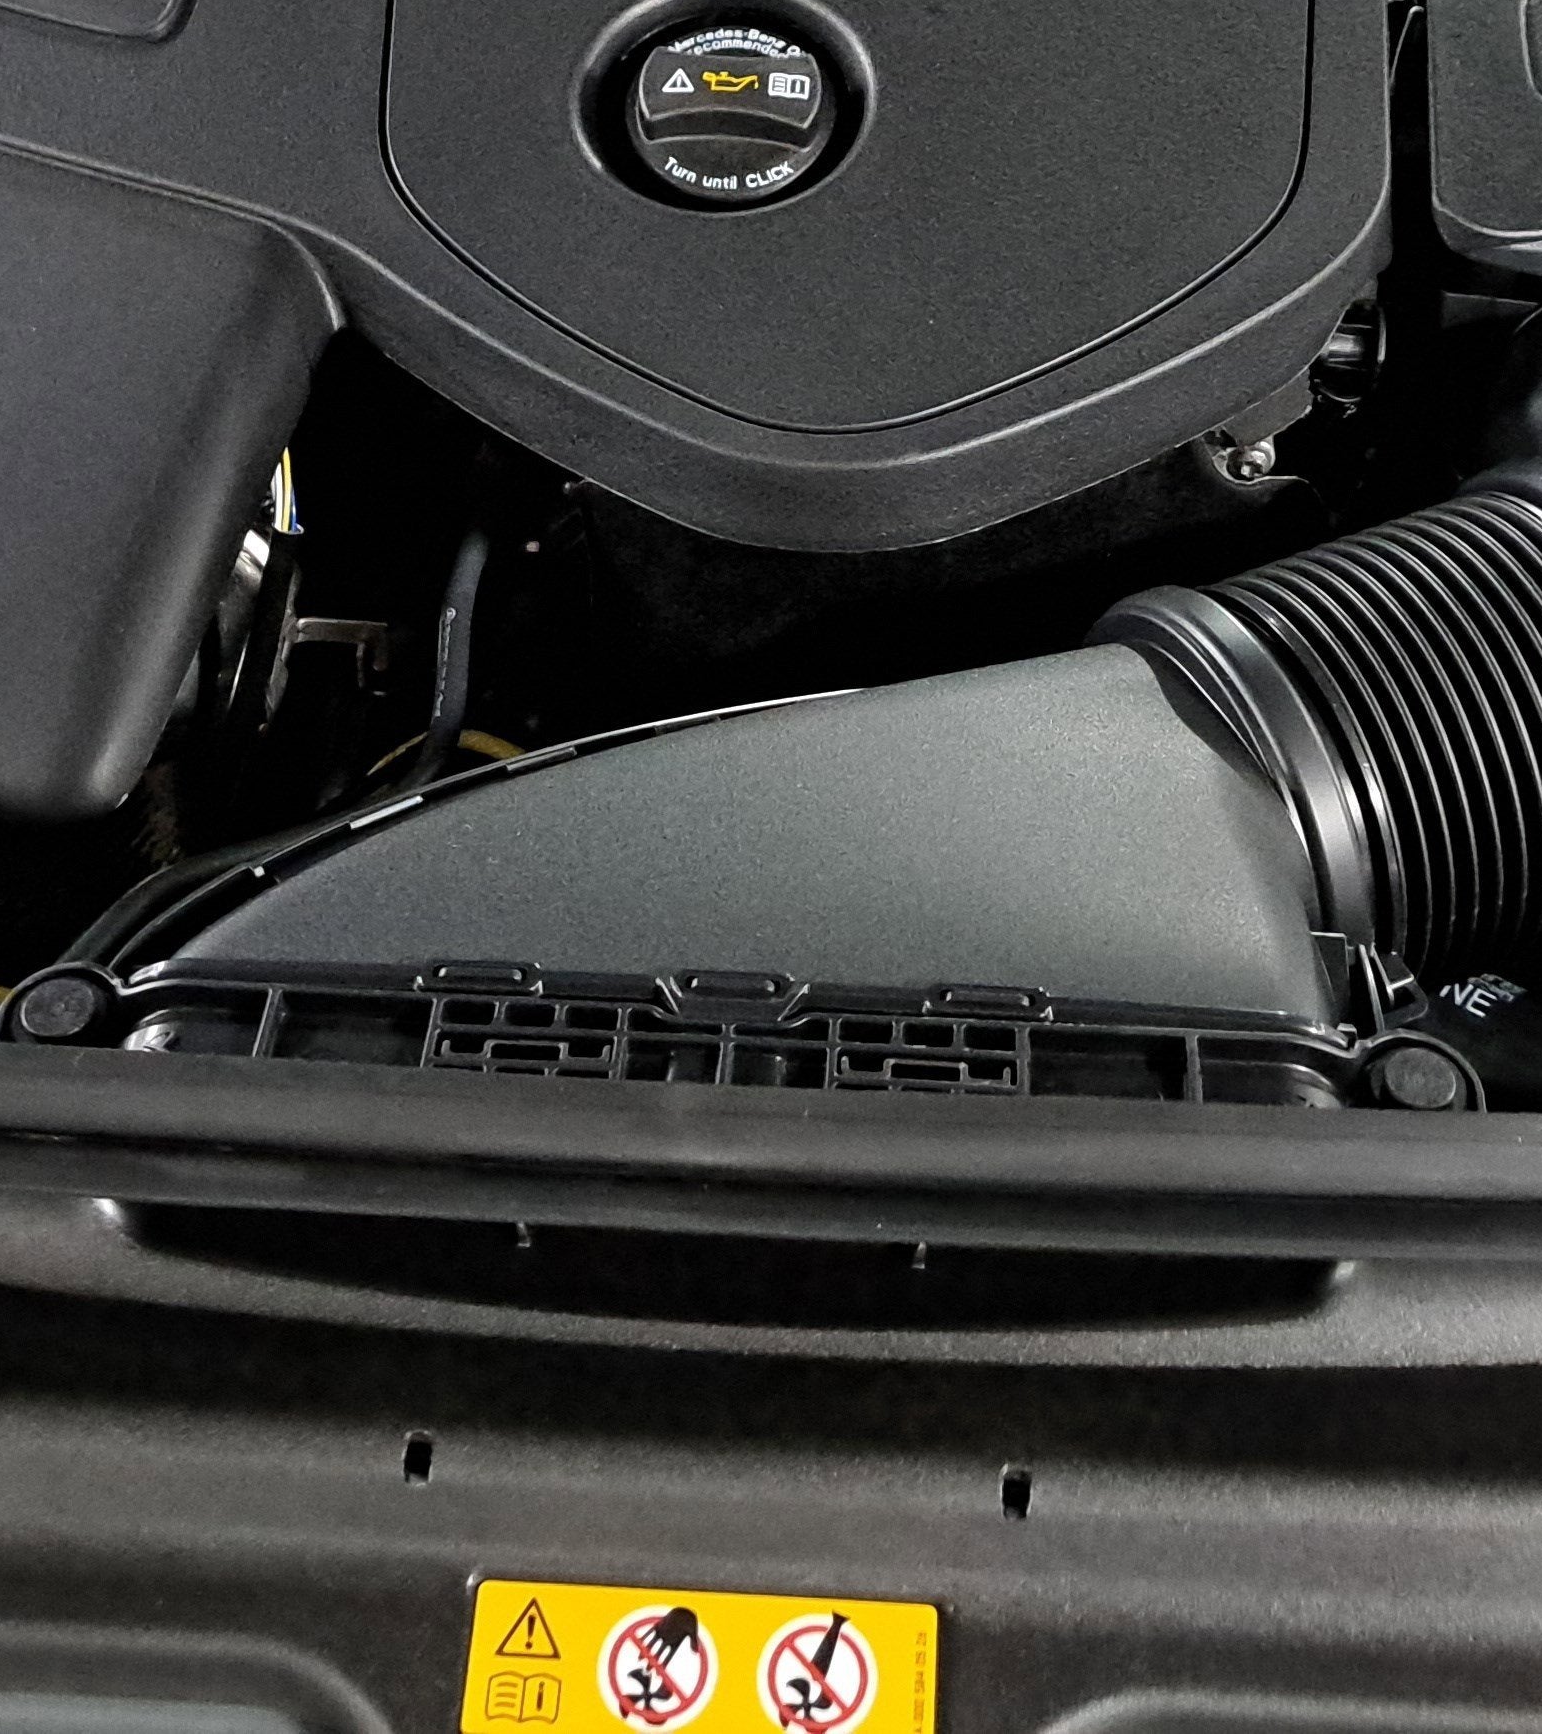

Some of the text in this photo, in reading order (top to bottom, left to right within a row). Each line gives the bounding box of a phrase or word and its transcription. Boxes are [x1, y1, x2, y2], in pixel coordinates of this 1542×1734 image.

[664, 156, 795, 190] Turn until CLICK
